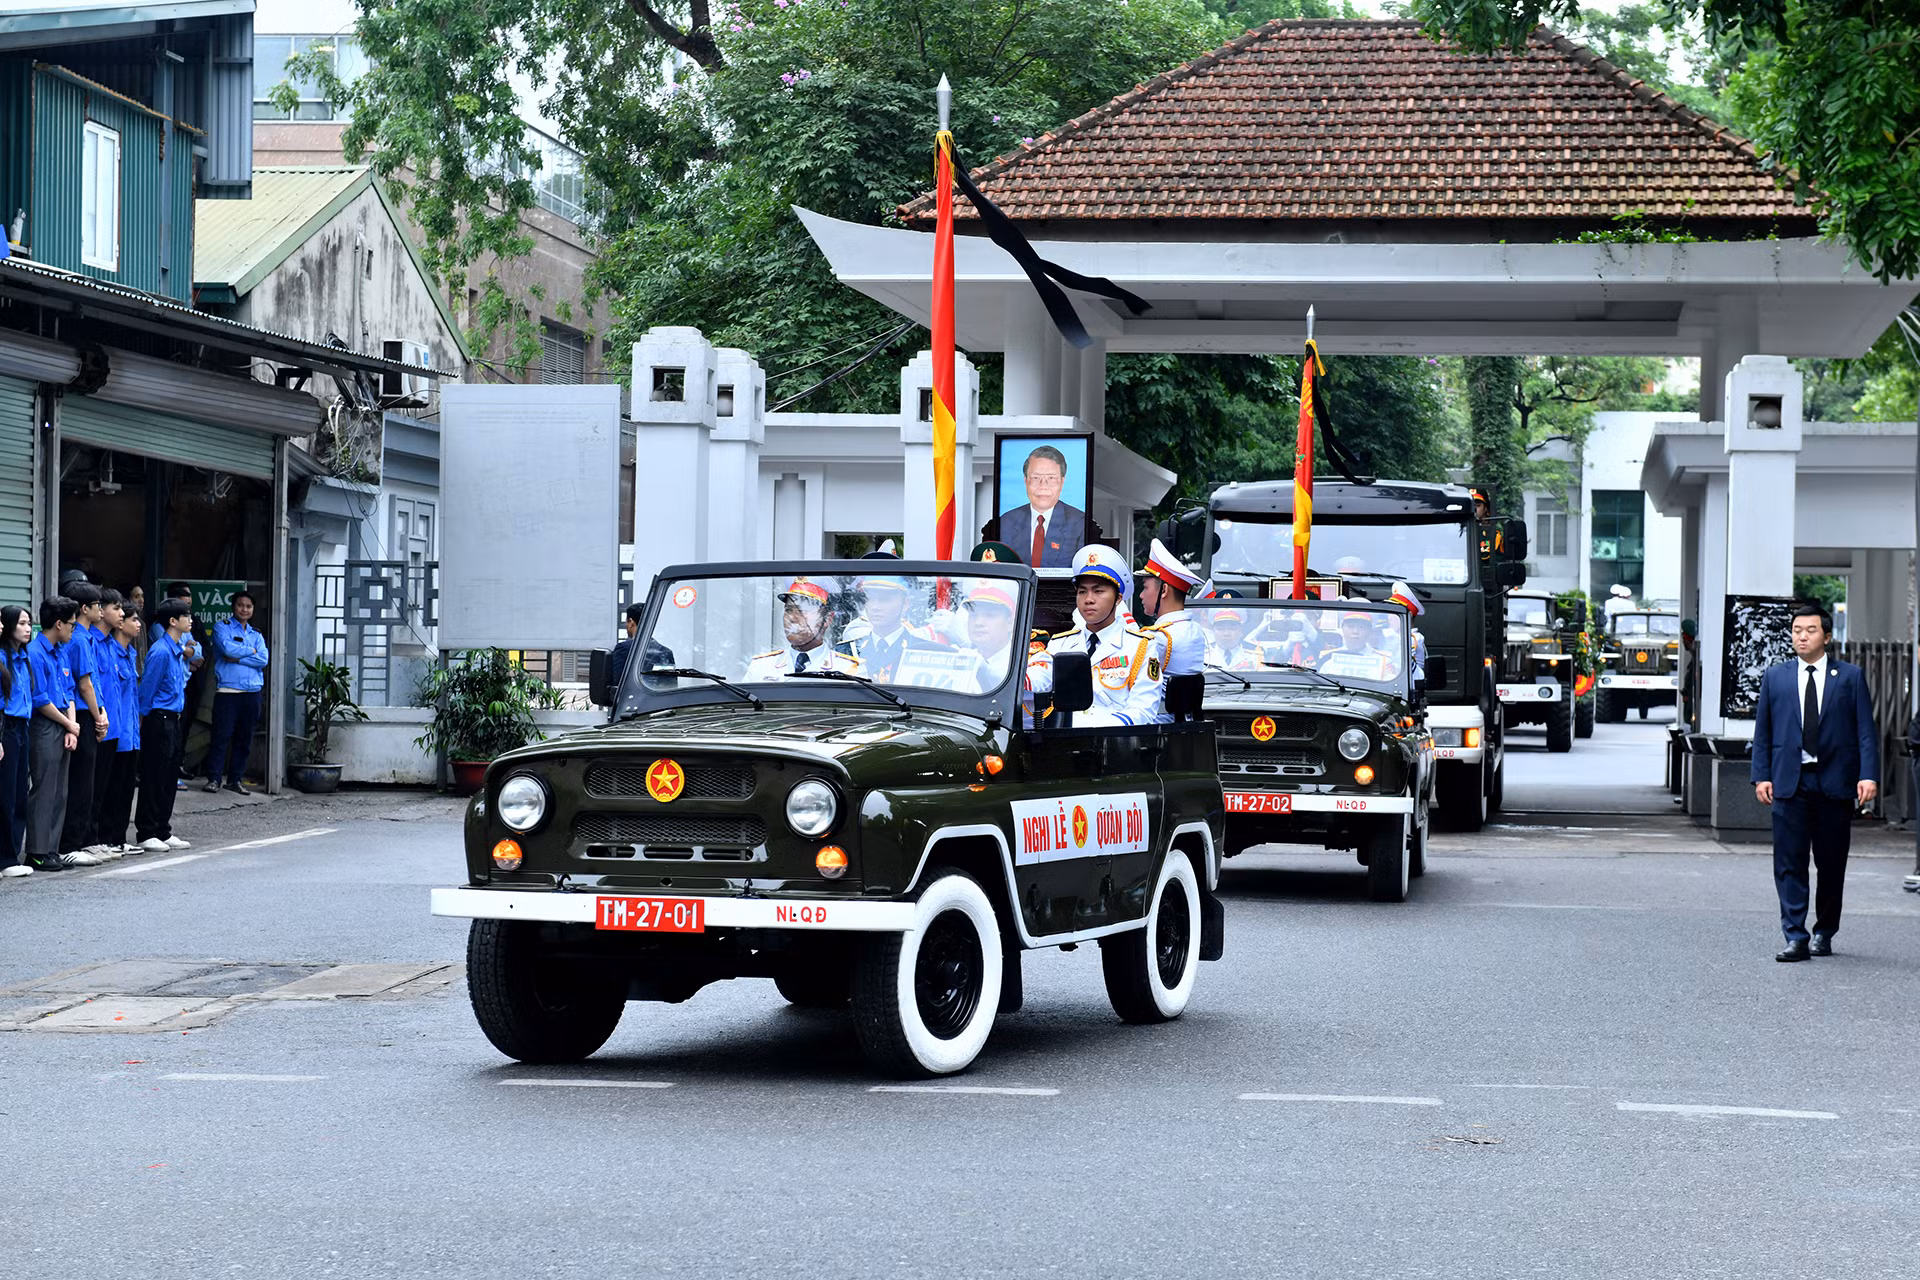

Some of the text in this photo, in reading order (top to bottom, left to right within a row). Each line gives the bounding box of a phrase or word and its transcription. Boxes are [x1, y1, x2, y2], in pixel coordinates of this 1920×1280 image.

[1225, 795, 1290, 812] TM-27-02
[1336, 800, 1367, 810] NLQĐ
[1023, 801, 1142, 853] NGHI LỄ QUÂN ĐỘI
[600, 900, 698, 929] TM-27-01
[776, 906, 827, 923] NLQĐ
